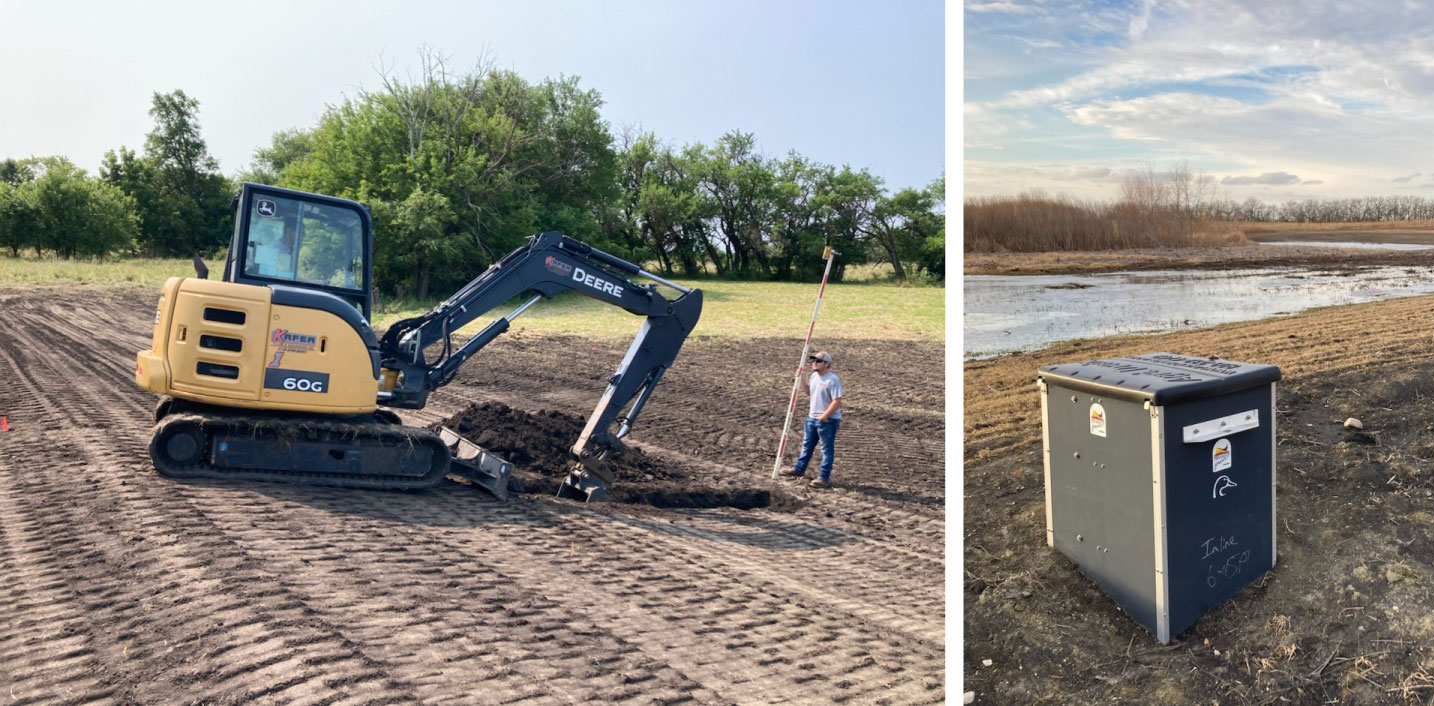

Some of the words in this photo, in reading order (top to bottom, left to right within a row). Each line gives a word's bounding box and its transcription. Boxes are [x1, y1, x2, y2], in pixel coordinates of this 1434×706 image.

[572, 267, 624, 297] DEERE
[271, 328, 316, 344] KAFER
[283, 378, 322, 392] 60G
[1201, 536, 1238, 559] Inline
